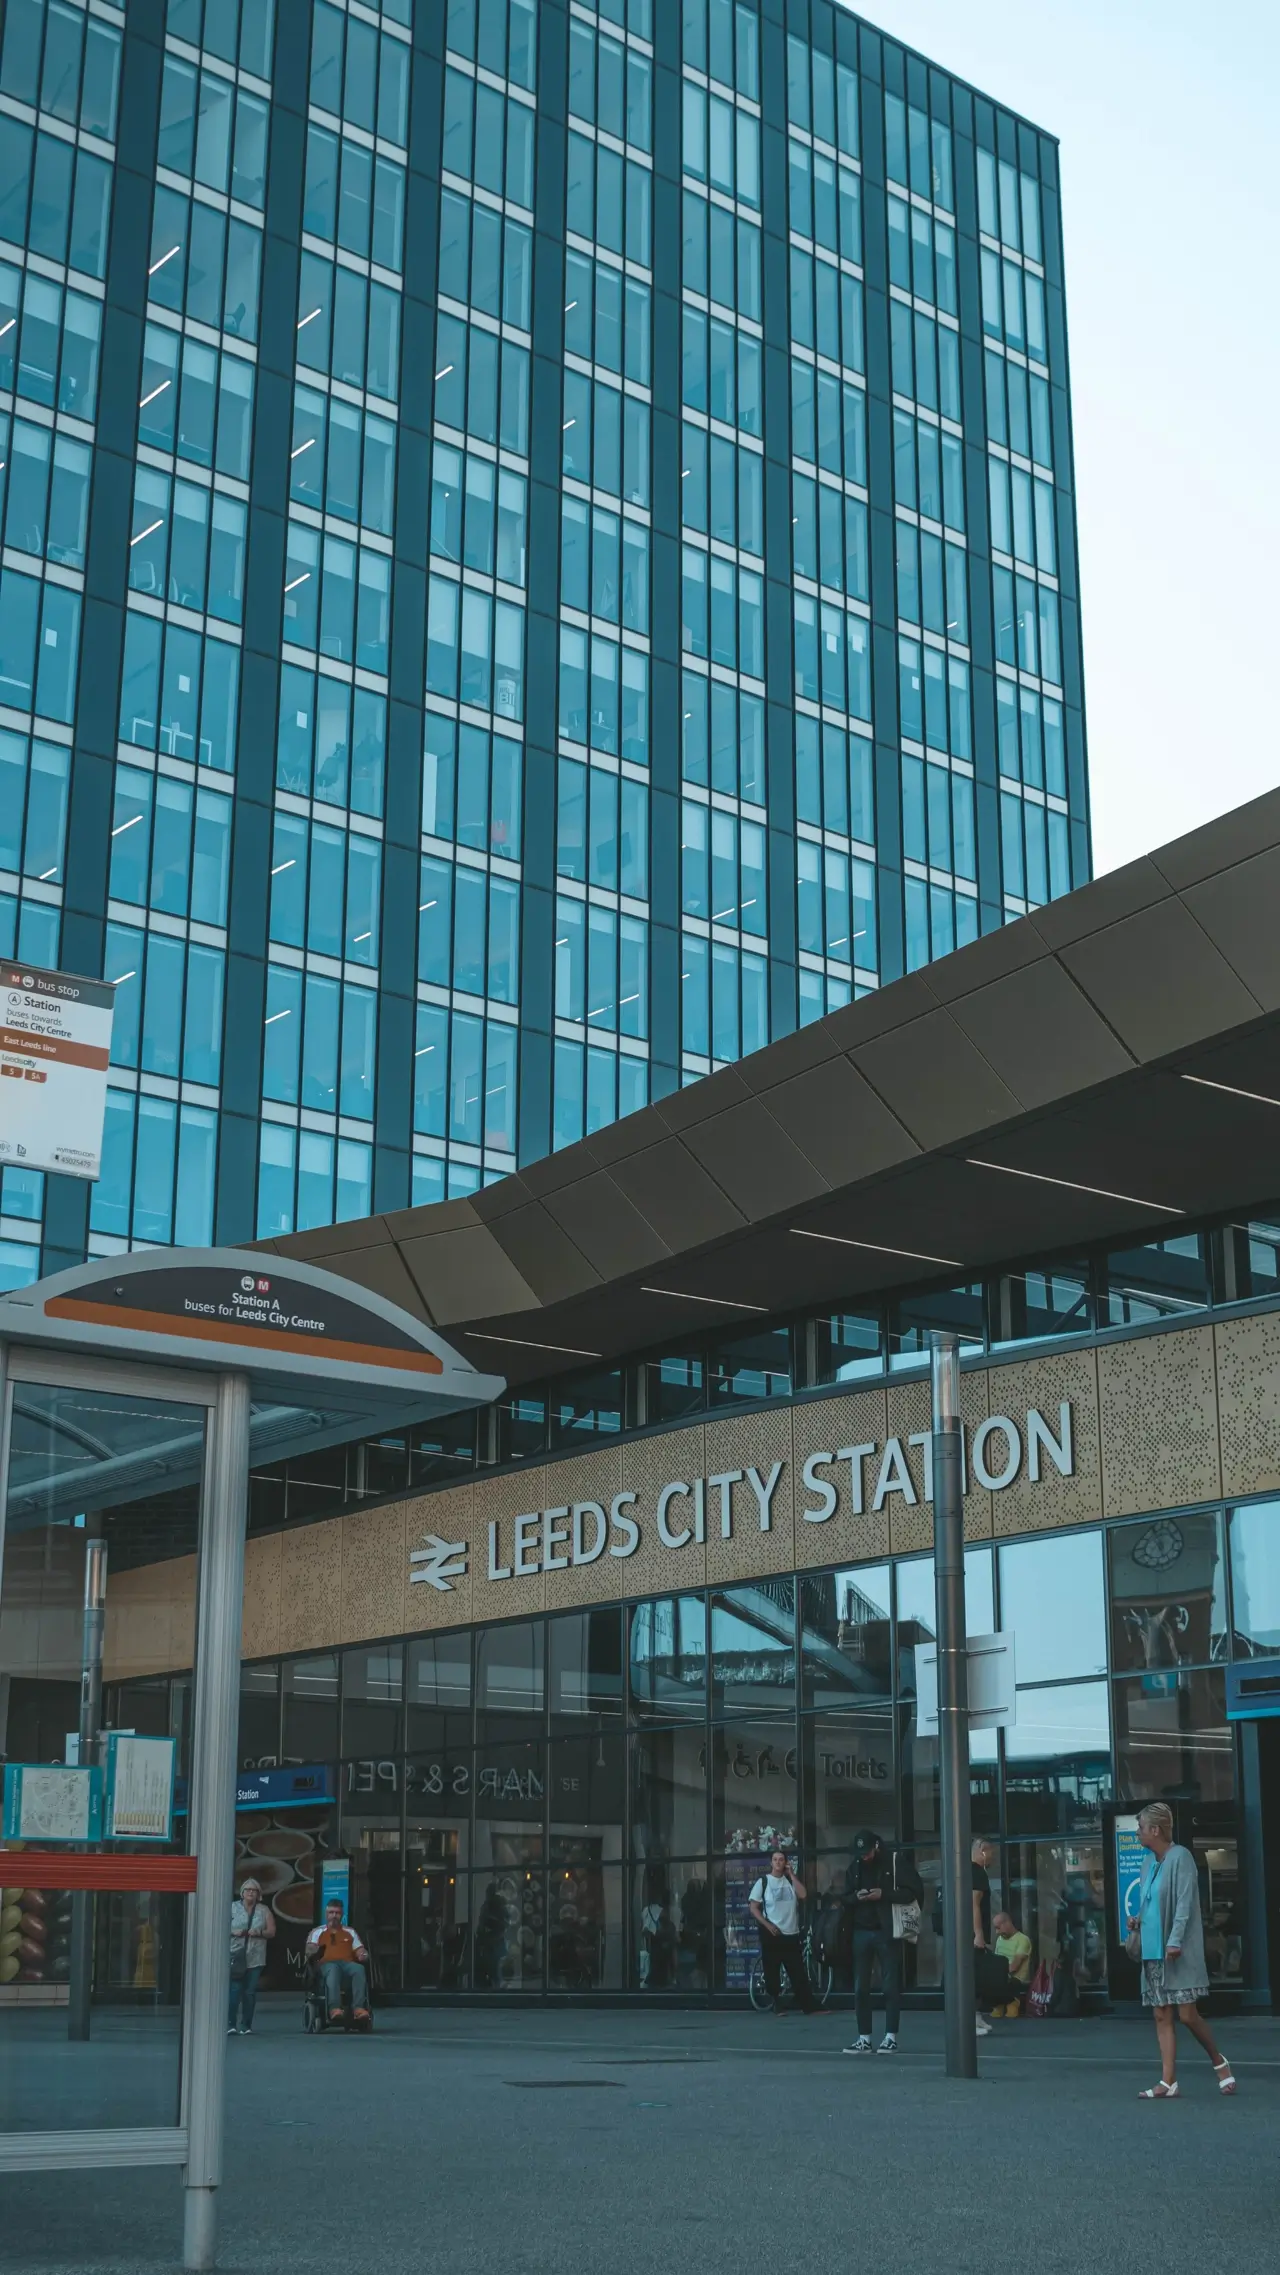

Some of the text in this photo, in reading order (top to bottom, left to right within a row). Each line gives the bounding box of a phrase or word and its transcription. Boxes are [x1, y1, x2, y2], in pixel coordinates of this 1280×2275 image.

[11, 975, 20, 983] M
[37, 979, 80, 999] bus stop
[24, 996, 61, 1013] Station
[7, 1008, 62, 1027] buses towards
[6, 1017, 73, 1039] Leeds City Centre
[3, 1035, 57, 1054] East Leeds line
[258, 1280, 269, 1291] M
[232, 1292, 281, 1311] Station A
[184, 1299, 325, 1331] buses for Leeds City Centre
[488, 1401, 1073, 1581] LEEDS CITY STATON
[818, 1751, 889, 1780] Toilets
[237, 1788, 260, 1801] Station
